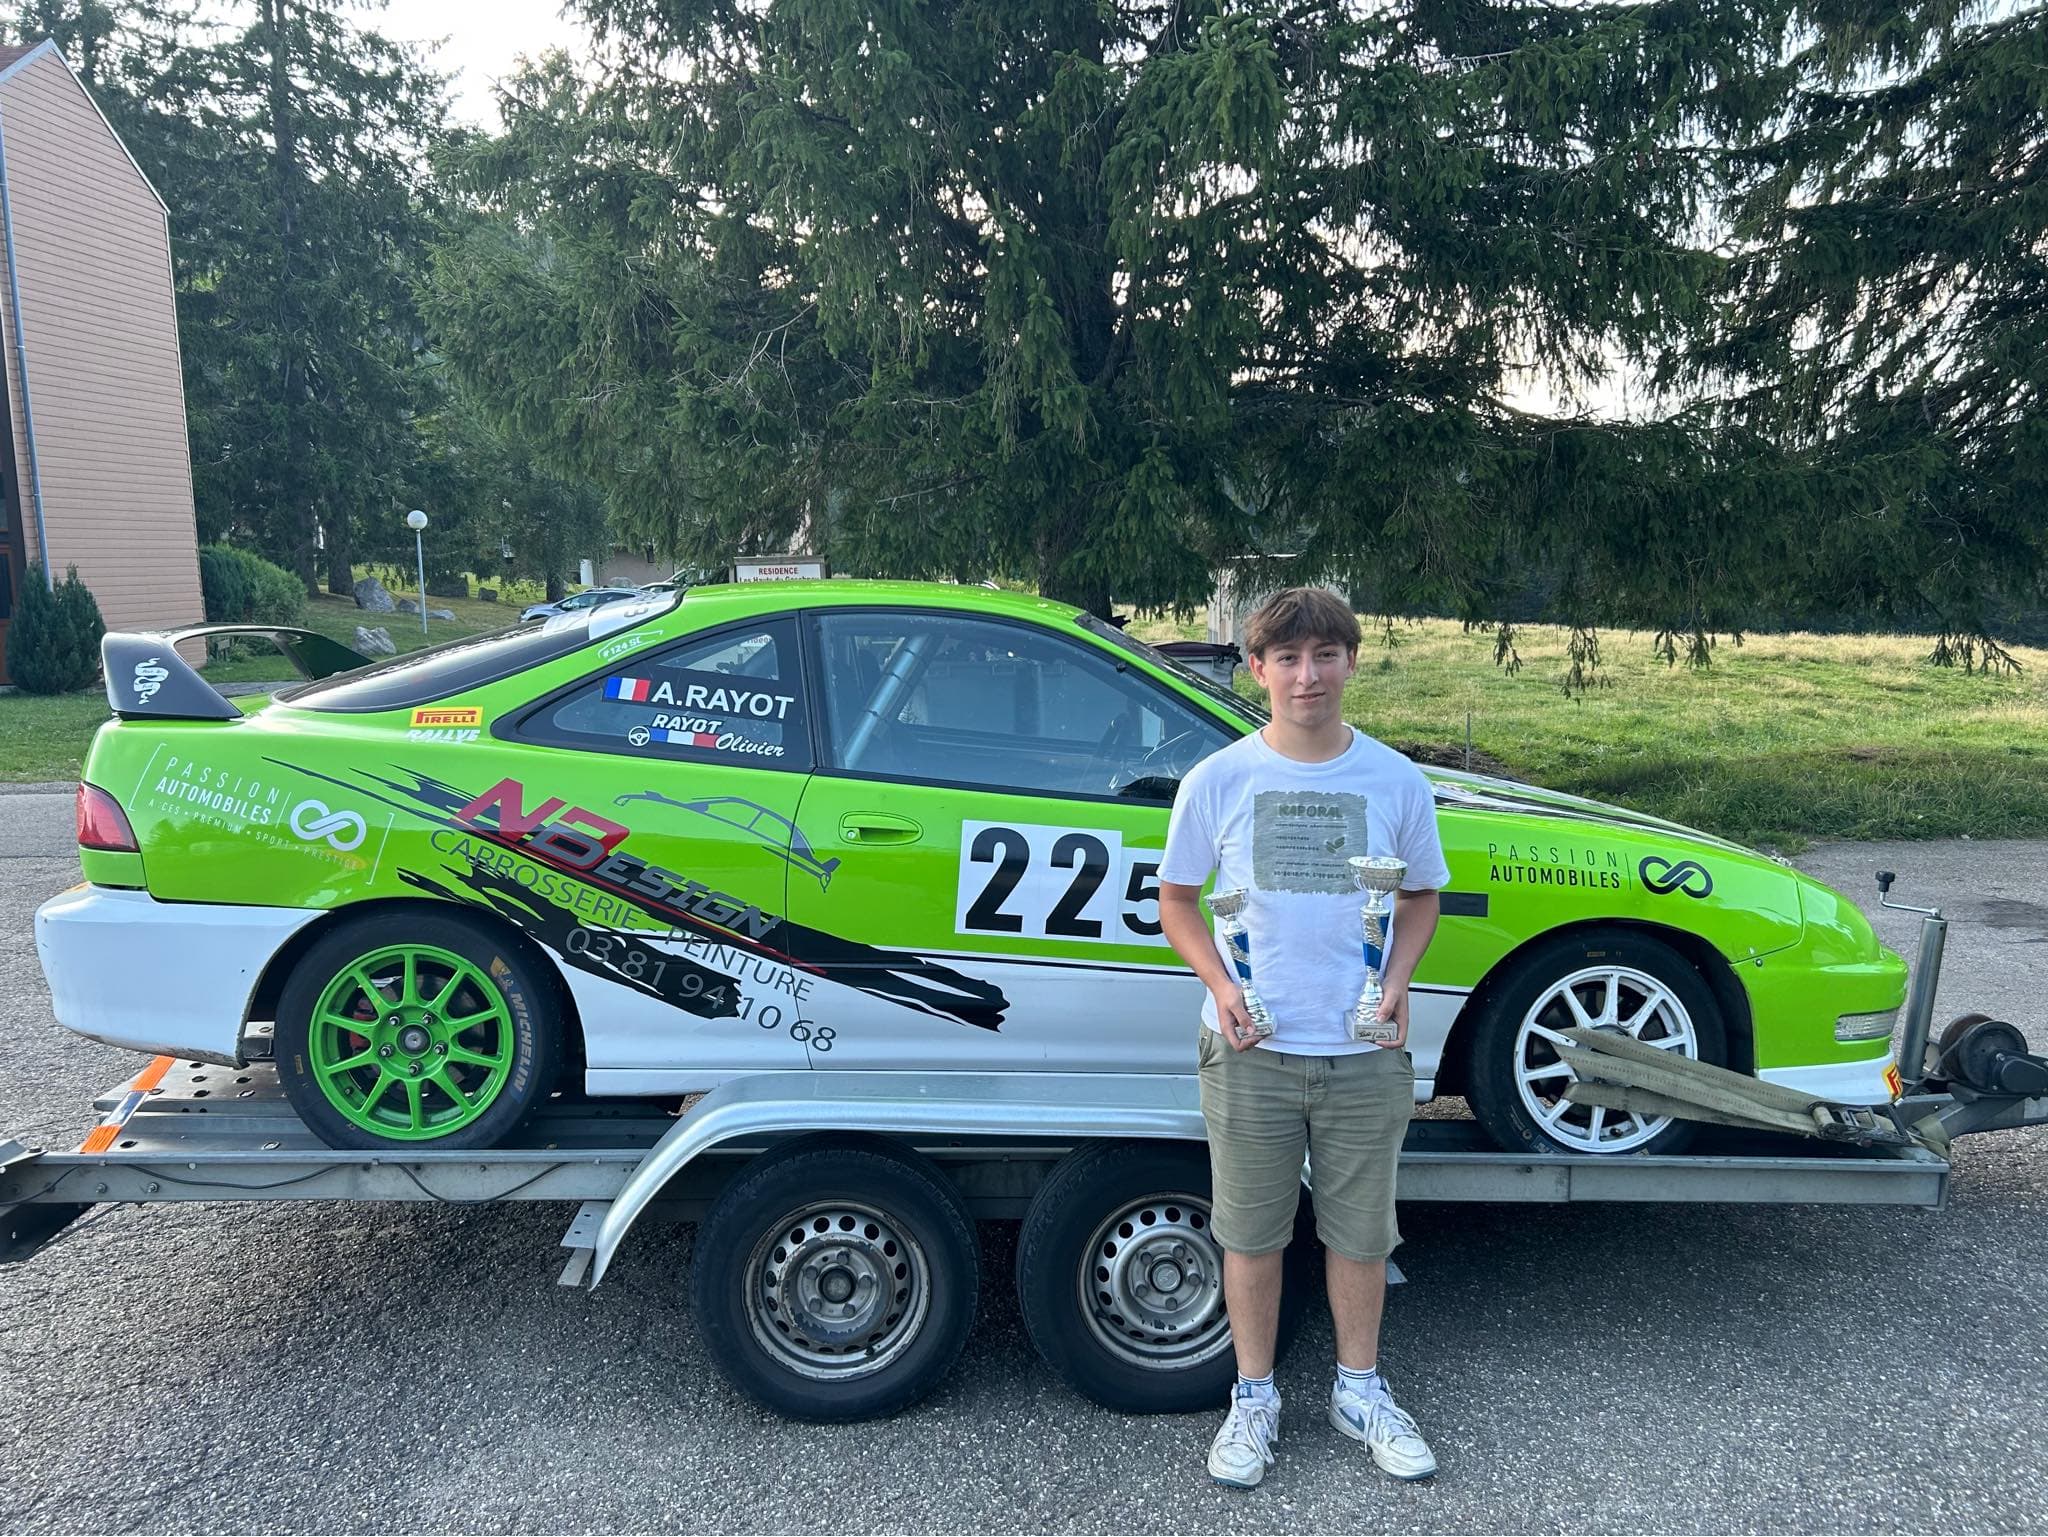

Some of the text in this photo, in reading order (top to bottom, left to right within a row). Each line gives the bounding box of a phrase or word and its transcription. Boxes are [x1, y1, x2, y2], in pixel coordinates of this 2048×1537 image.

[758, 567, 799, 575] RESIDENCE
[651, 681, 795, 720] A.RAYOT
[416, 710, 477, 724] PIRELLI
[652, 714, 722, 734] RAYOT
[715, 732, 785, 757] Olivier
[165, 757, 280, 804] PASSION
[155, 776, 272, 825] AUTOMOBILES
[255, 831, 290, 848] SPORT
[1488, 843, 1618, 868] PASSION
[965, 827, 1165, 938] 225
[1490, 864, 1620, 889] AUTOMOBILES
[430, 829, 639, 932] CARROSSERIE
[667, 926, 815, 1002] PEINTURE
[565, 927, 838, 1053] 03 81 94 10 68
[510, 992, 532, 1093] MICHELIN
